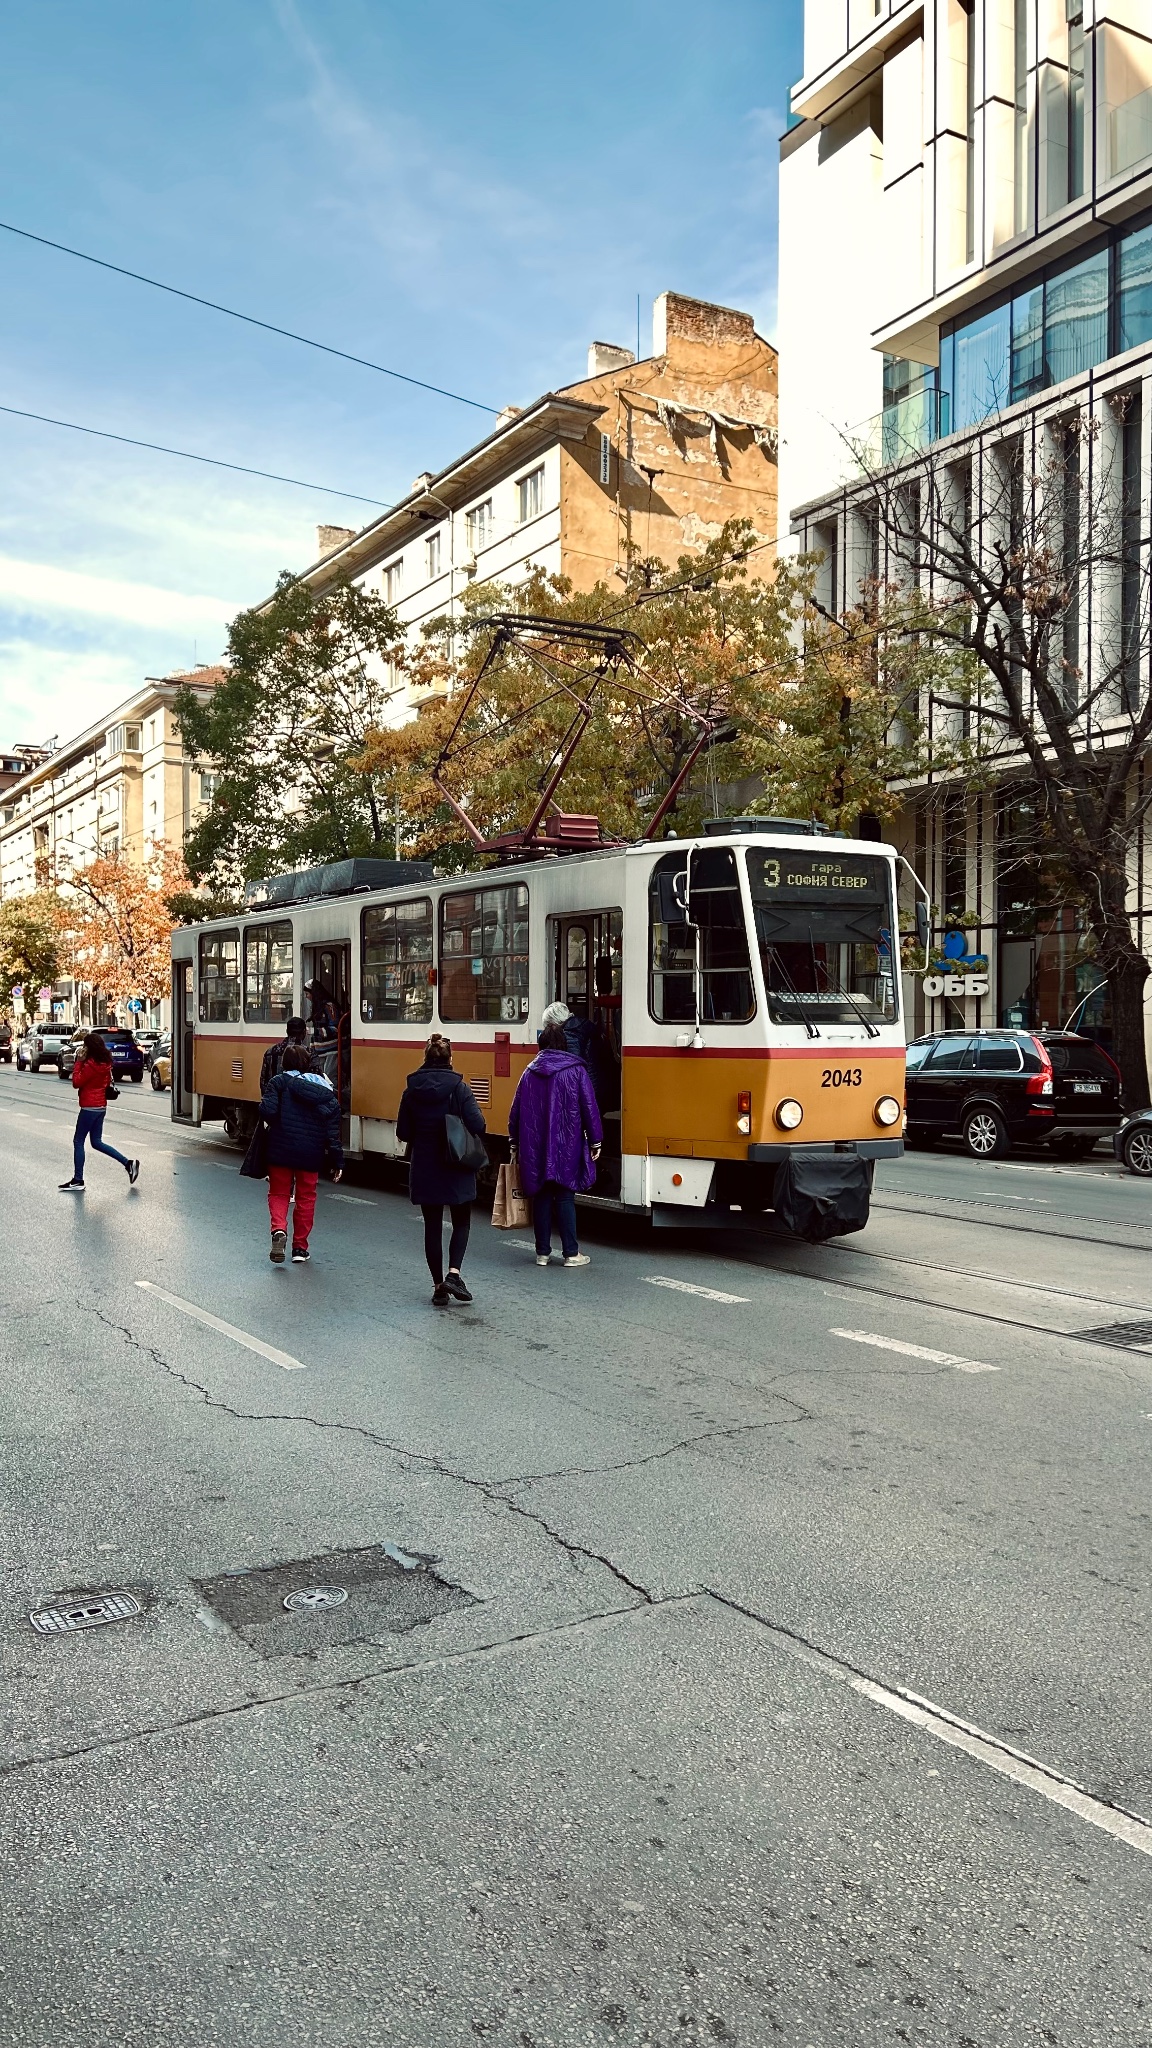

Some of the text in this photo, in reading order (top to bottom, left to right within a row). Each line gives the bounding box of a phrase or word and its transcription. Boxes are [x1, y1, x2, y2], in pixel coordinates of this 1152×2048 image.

[763, 858, 781, 888] 3
[811, 863, 842, 874] гара
[831, 876, 868, 888] СЕВЕР
[923, 974, 988, 997] ОББ
[507, 997, 515, 1019] 3
[821, 1068, 862, 1088] 2043
